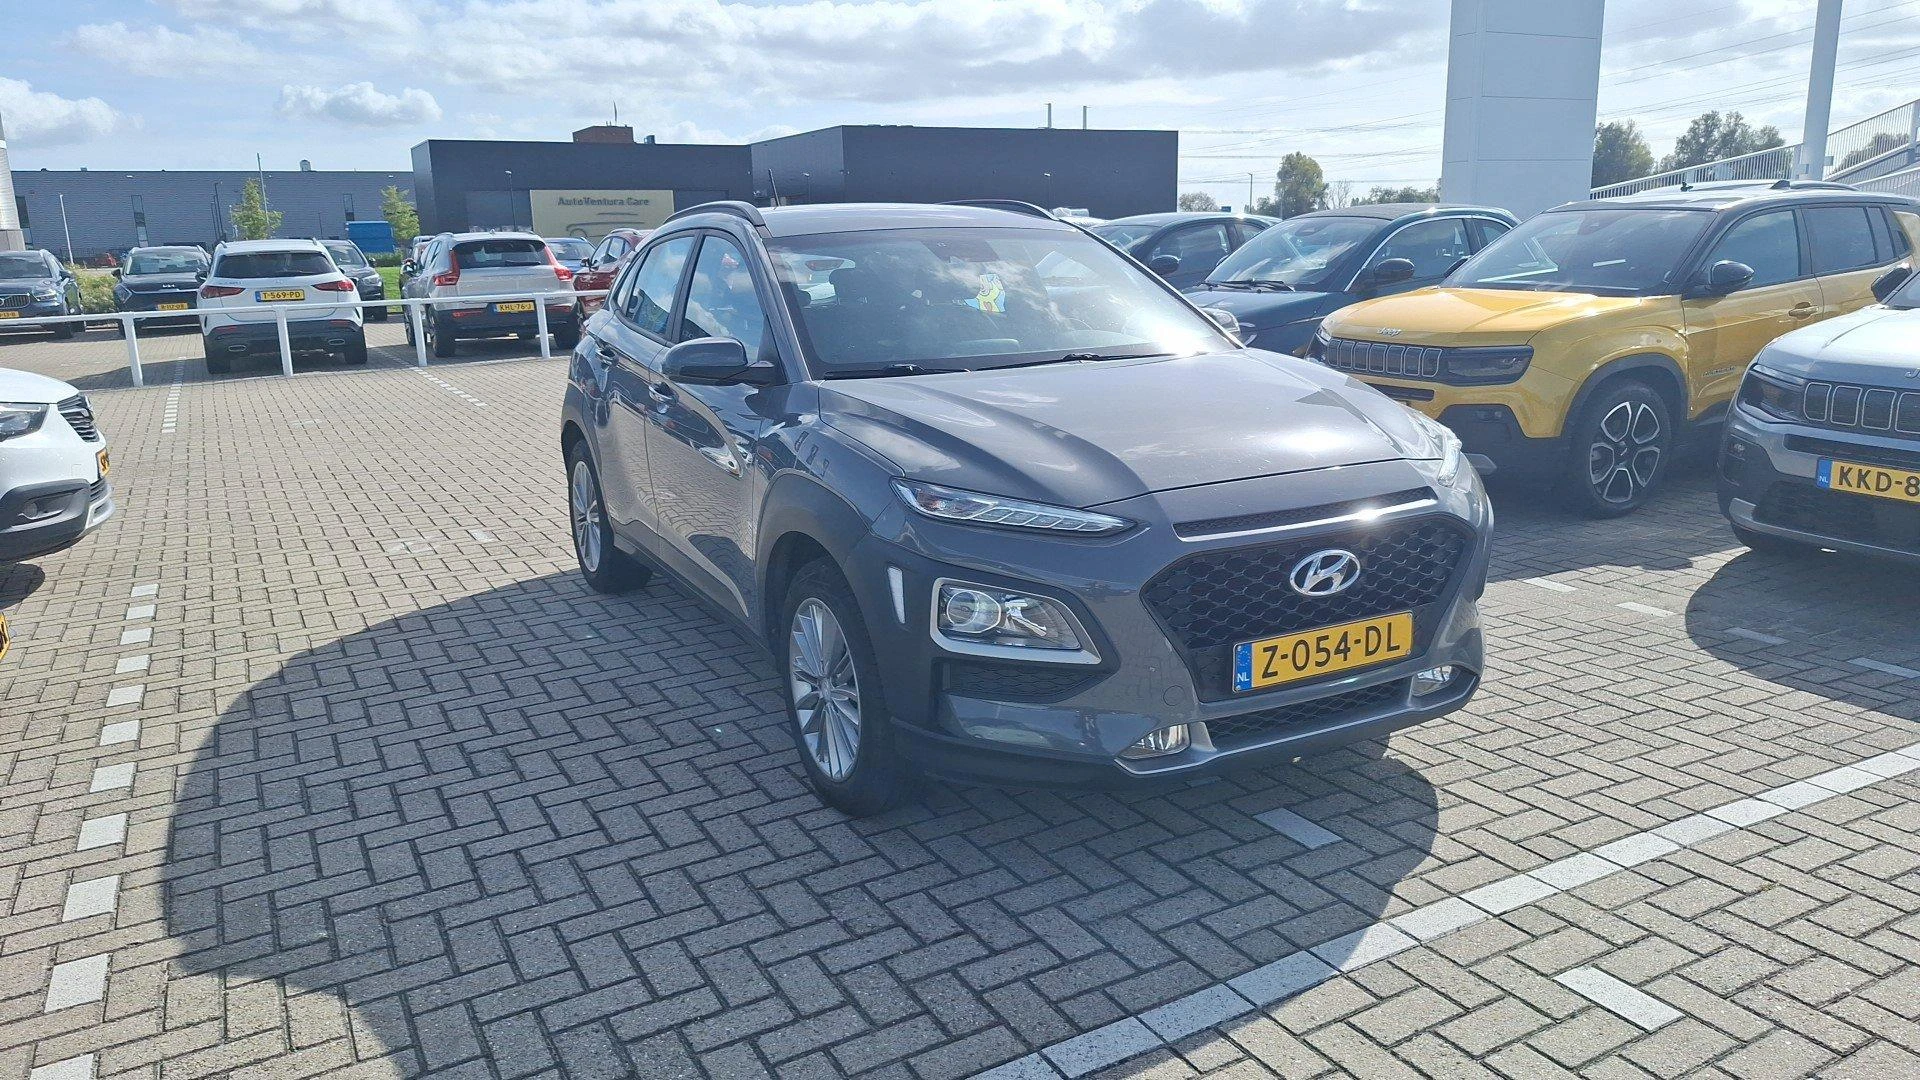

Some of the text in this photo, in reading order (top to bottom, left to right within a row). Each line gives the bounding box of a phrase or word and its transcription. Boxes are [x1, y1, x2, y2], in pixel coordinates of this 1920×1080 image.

[558, 196, 649, 206] AutoVentura Care
[262, 291, 301, 299] T-569-PD
[1819, 465, 1920, 497] NL KKD-8
[1237, 622, 1400, 682] NL Z-054-DL
